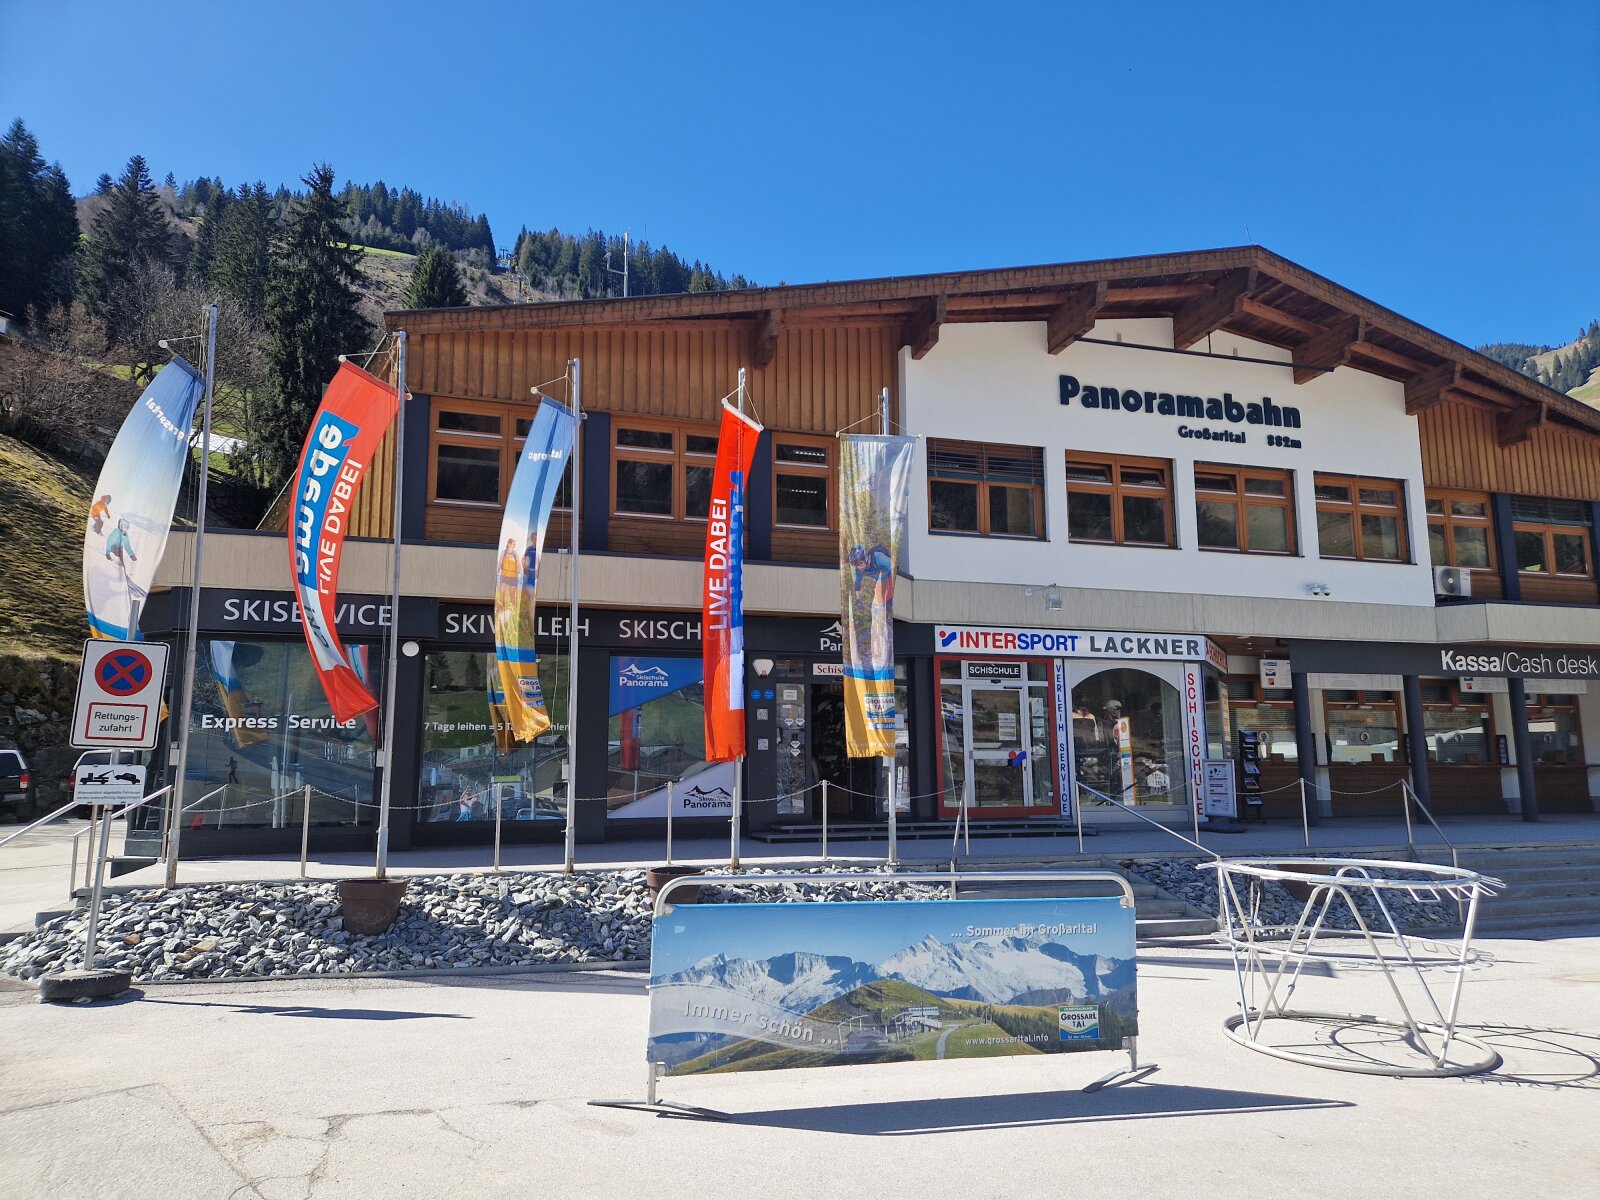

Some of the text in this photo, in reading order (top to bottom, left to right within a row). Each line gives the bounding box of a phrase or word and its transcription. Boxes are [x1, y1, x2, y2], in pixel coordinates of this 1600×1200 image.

[1059, 374, 1302, 428] Panoramabahn
[1178, 425, 1302, 449] Großarltal 882m
[709, 498, 728, 631] LIVE DABEI
[223, 599, 392, 626] SKISEVICE
[445, 613, 590, 637] SKIVLEIH
[619, 619, 702, 640] SKISCH
[960, 630, 1199, 655] INTERSPORT LACKNER
[969, 666, 1020, 675] SCHISCHULE
[1441, 650, 1598, 674] Kassa/Cash desk
[620, 677, 668, 687] Panorama
[94, 711, 140, 722] Rettungs-
[201, 715, 356, 731] Express Service
[432, 723, 454, 732] Tage
[457, 722, 486, 730] leihen
[99, 724, 132, 732] zufahrt
[1056, 664, 1068, 813] VERLEIH SERVICE
[1187, 673, 1203, 815] SCHISCHULE
[683, 799, 732, 808] Panorama
[966, 925, 1014, 937] Sommer
[1019, 923, 1034, 934] im
[1038, 923, 1097, 937] Großarltal
[684, 999, 751, 1024] Immer
[758, 1014, 814, 1042] schön
[966, 1034, 1049, 1045] www.grossarltal.info
